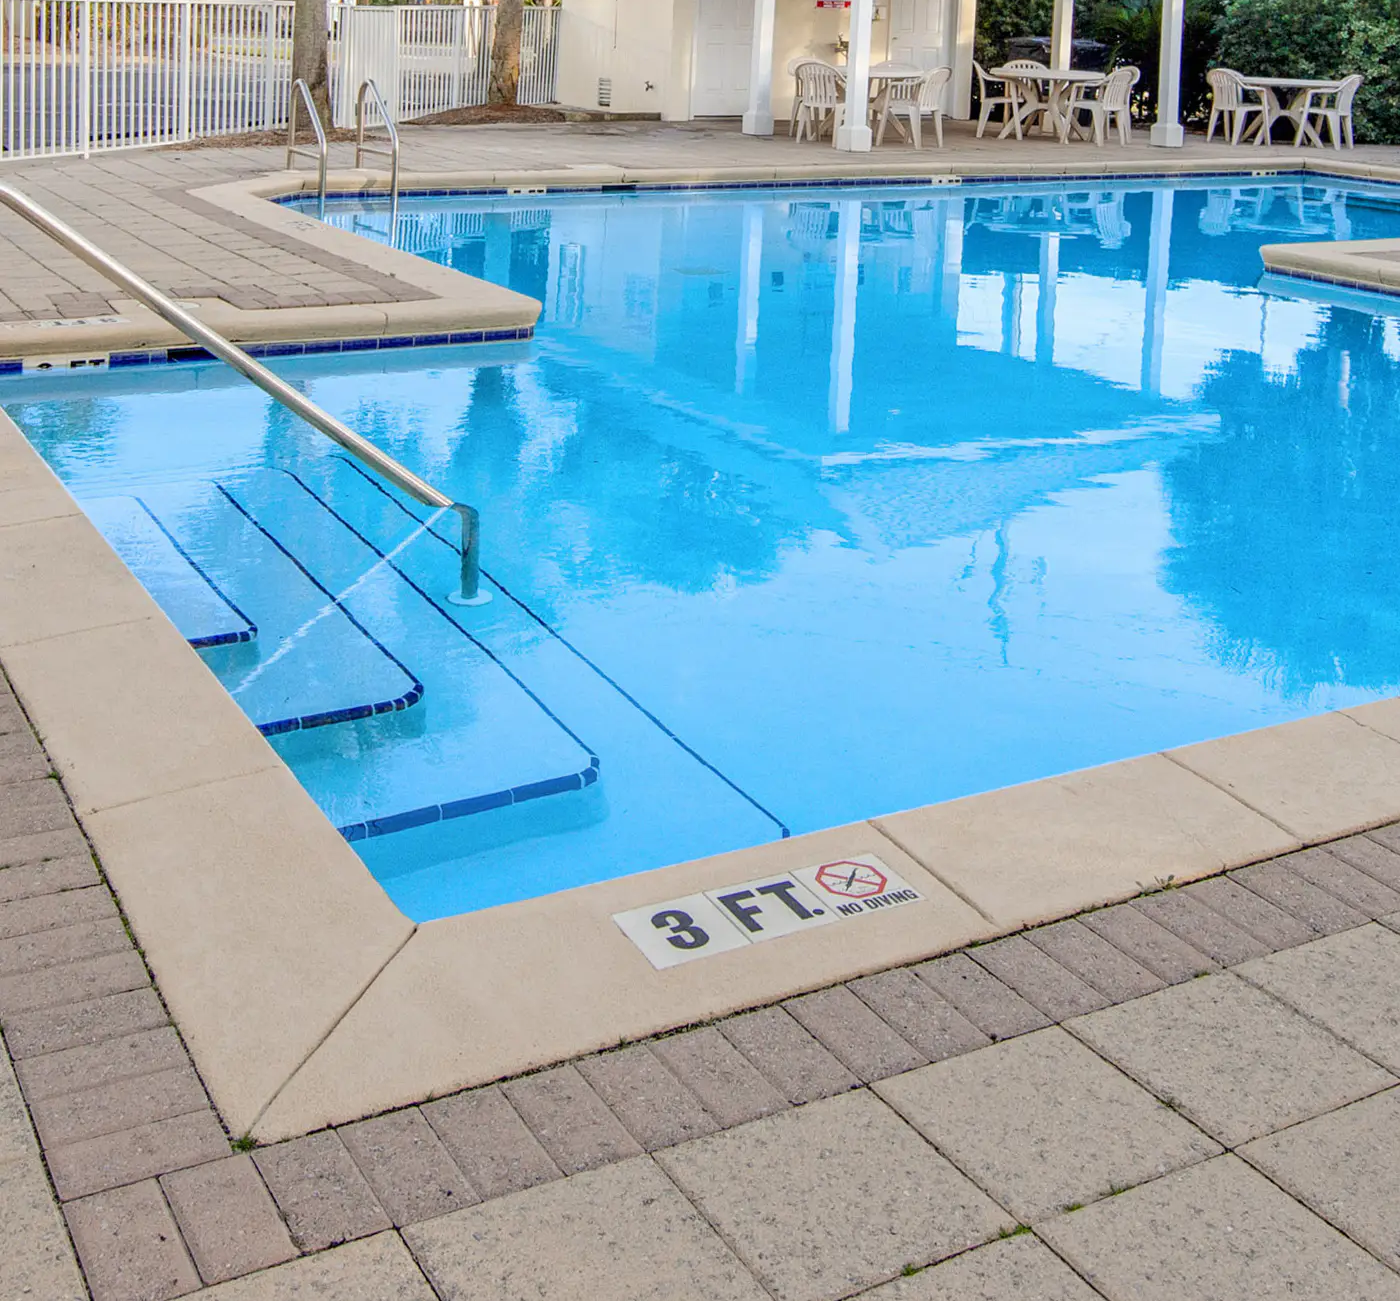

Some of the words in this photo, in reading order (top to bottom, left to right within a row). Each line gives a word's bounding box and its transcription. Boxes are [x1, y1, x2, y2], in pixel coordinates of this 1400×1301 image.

[651, 908, 710, 951] 3
[717, 880, 825, 933] FT.
[836, 902, 863, 917] NO
[866, 889, 919, 910] DIVING
